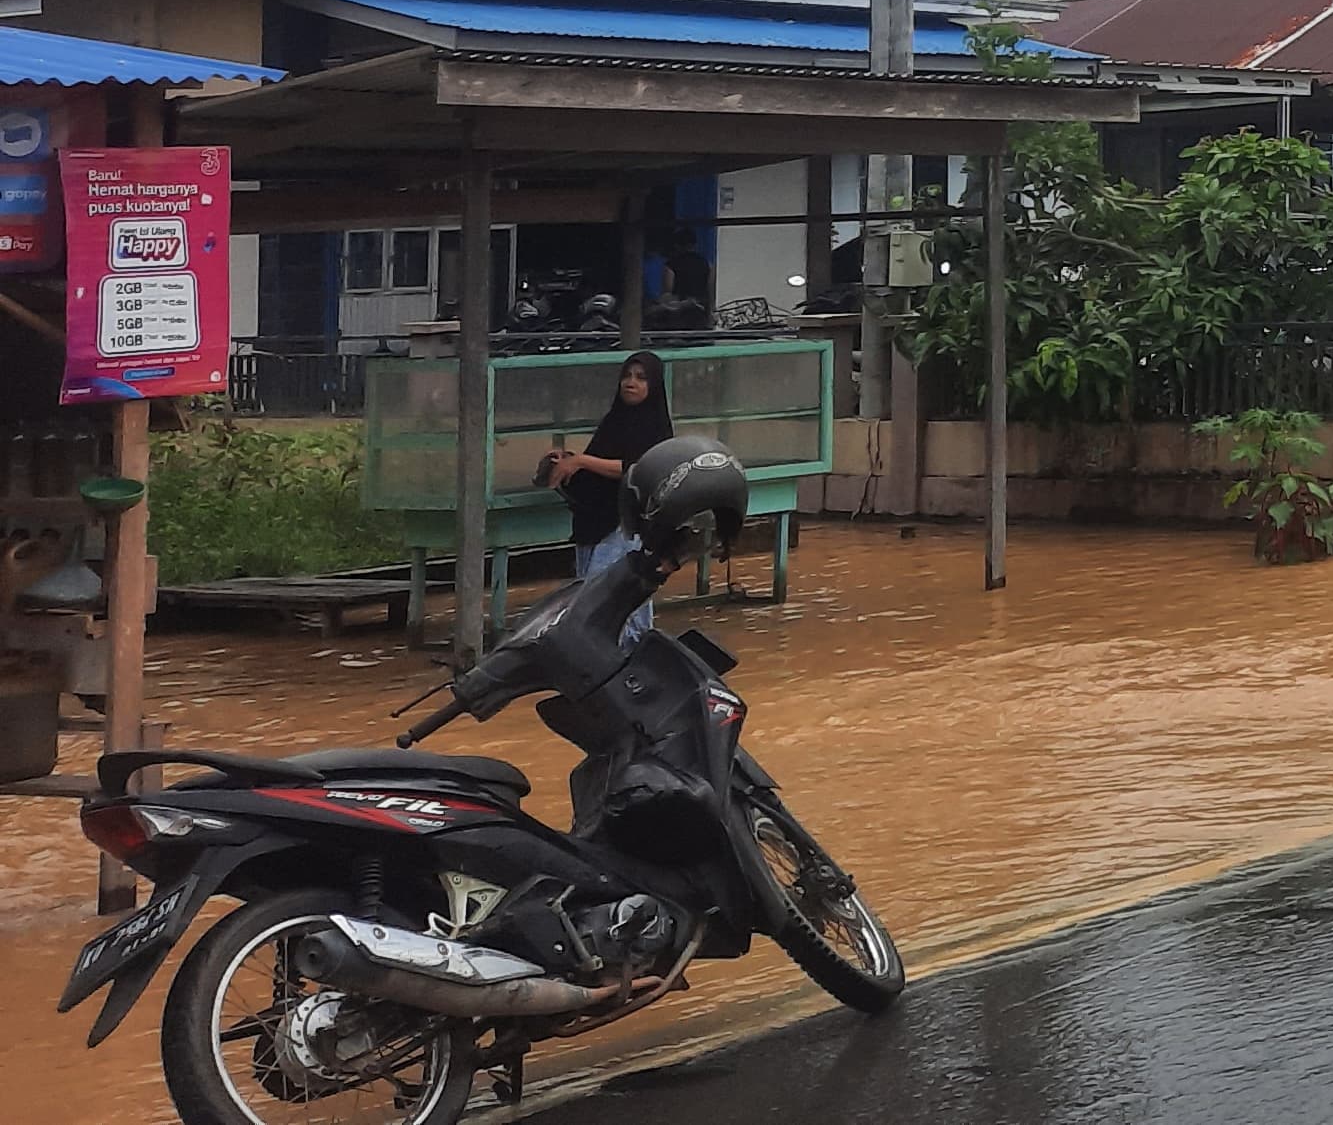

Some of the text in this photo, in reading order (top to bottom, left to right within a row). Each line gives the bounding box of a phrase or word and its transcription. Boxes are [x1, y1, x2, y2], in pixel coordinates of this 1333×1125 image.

[88, 184, 198, 197] Hemat harganya
[88, 199, 190, 216] puas kuotanya!
[118, 236, 179, 259] Happy
[115, 282, 142, 295] 2GB
[116, 299, 142, 312] 3GB
[116, 317, 143, 330] 5GB
[110, 334, 143, 348] 10GB
